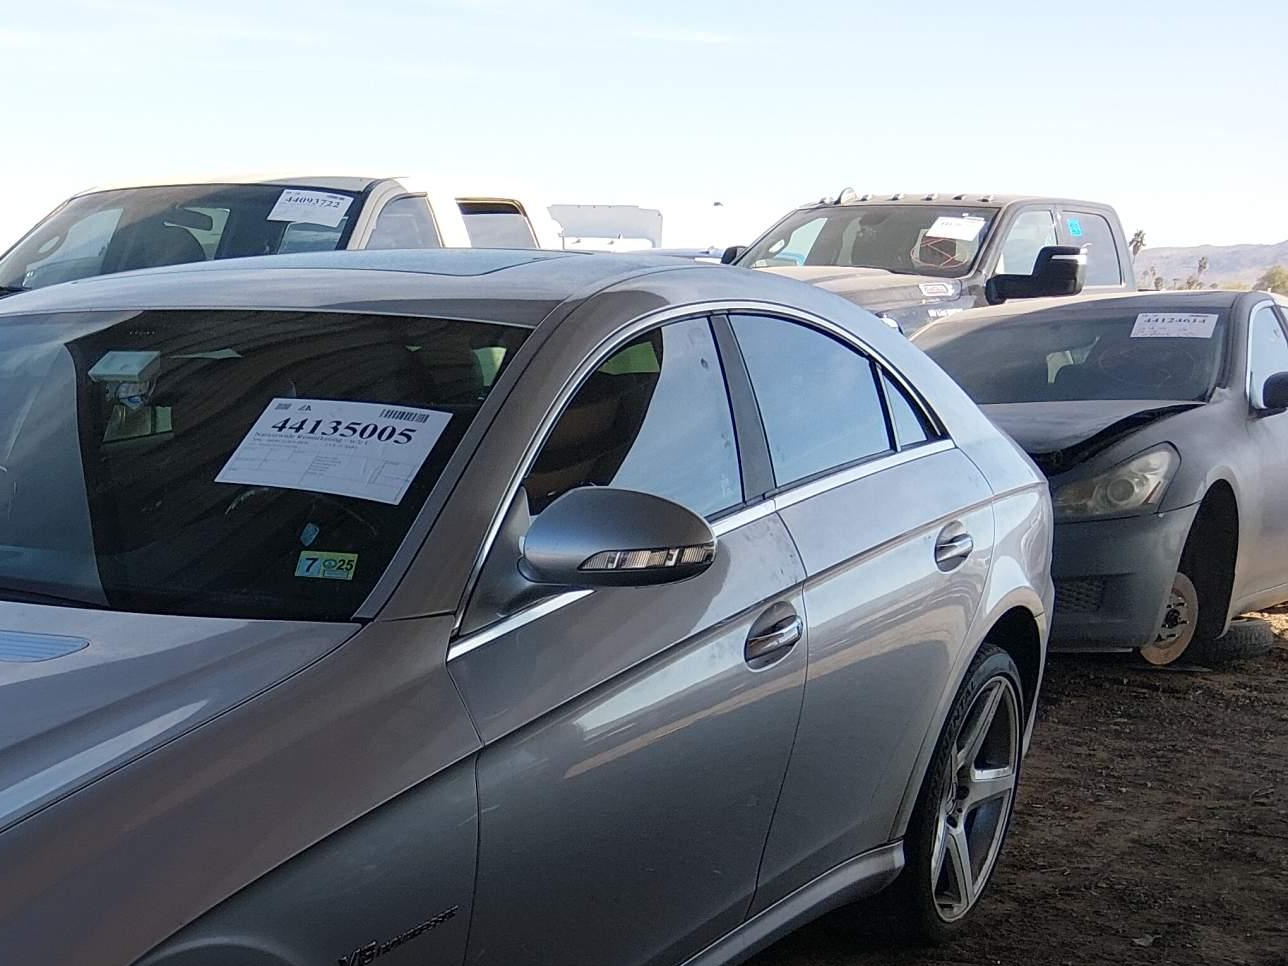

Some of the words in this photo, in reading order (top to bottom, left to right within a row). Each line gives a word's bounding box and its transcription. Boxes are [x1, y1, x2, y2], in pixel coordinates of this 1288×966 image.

[271, 416, 417, 445] 44135005
[305, 557, 320, 573] 7
[336, 559, 355, 572] 25
